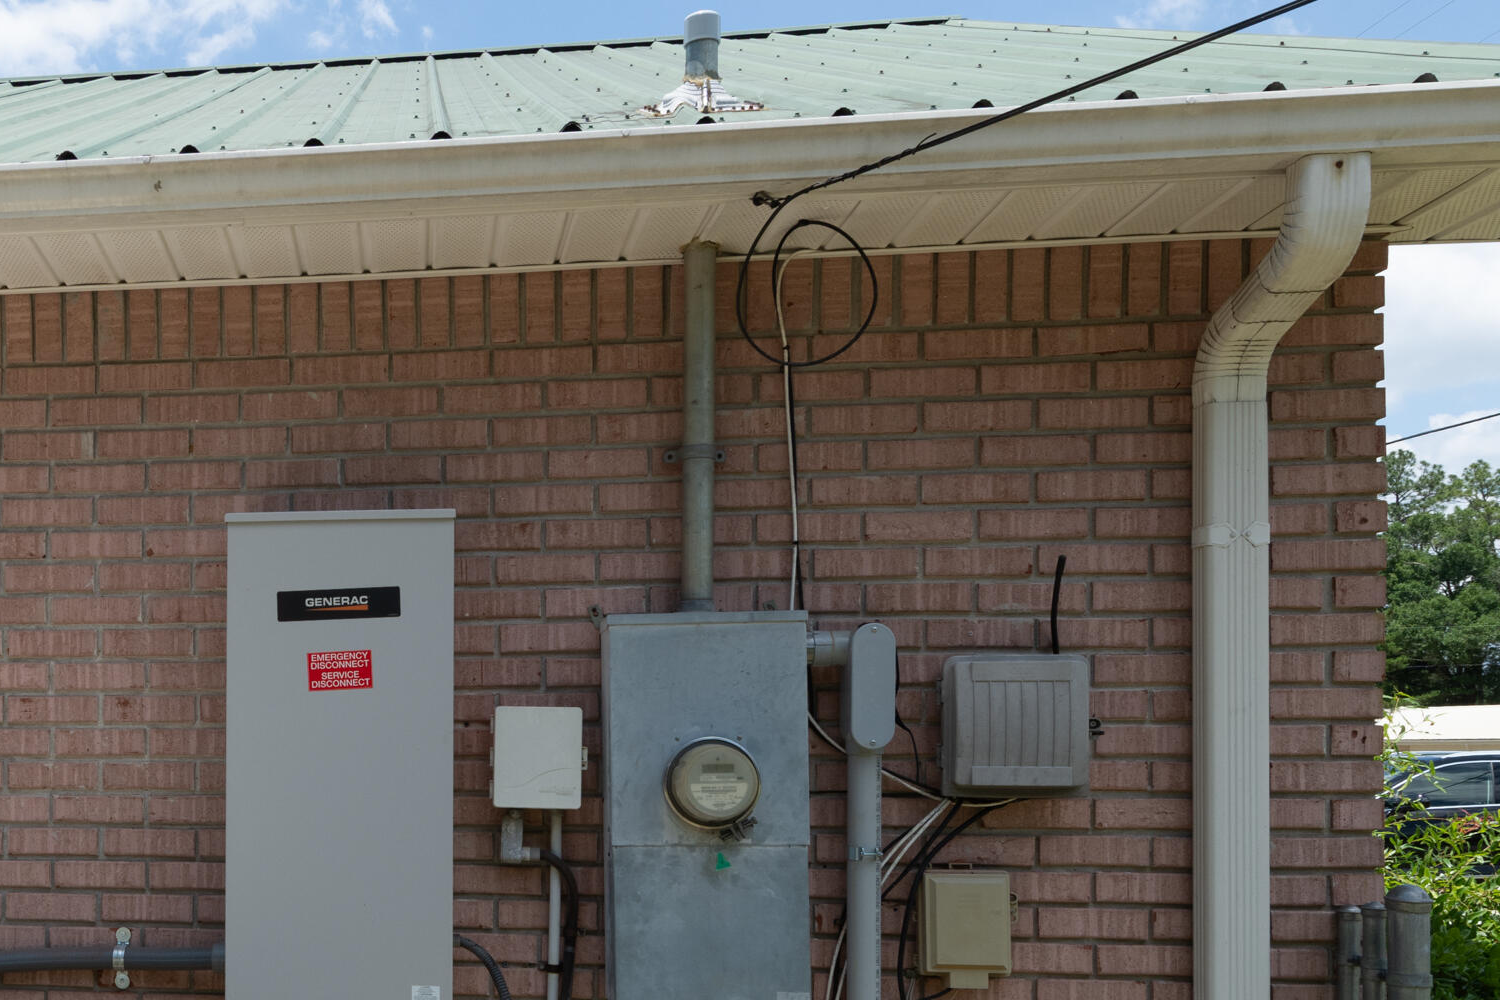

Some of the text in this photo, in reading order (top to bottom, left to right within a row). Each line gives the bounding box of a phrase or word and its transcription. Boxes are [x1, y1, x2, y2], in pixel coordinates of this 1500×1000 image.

[305, 596, 368, 607] GENERAC
[311, 652, 368, 661] EMERGENCY
[311, 660, 369, 670] DISCONNECT
[321, 671, 360, 679] SERVICE
[311, 678, 370, 688] DISCONNECT
